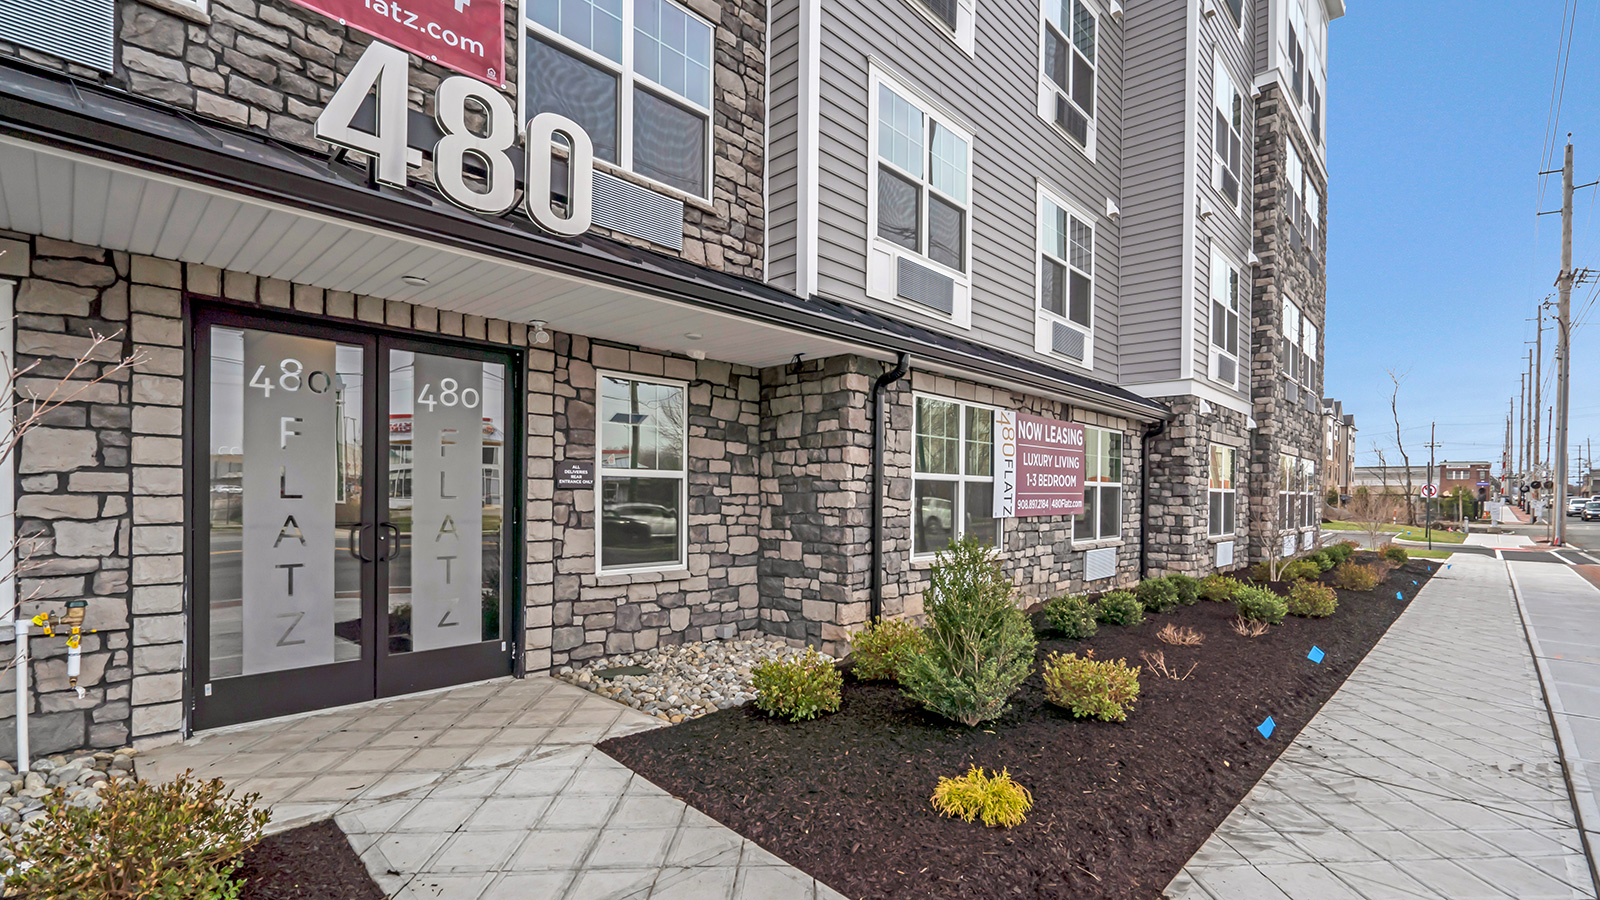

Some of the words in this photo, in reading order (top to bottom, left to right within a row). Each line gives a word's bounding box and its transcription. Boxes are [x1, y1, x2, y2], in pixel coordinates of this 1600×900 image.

[313, 40, 594, 237] 480
[249, 358, 331, 398] 480
[417, 377, 479, 412] 480
[1018, 420, 1043, 441] NOW
[1045, 424, 1083, 446] LEASING
[1023, 452, 1053, 469] LUXURY
[1054, 455, 1080, 469] LIVING
[1026, 473, 1037, 487] 1-3
[1038, 474, 1077, 487] BEDROOM
[1051, 499, 1083, 509] 480Flatz.com
